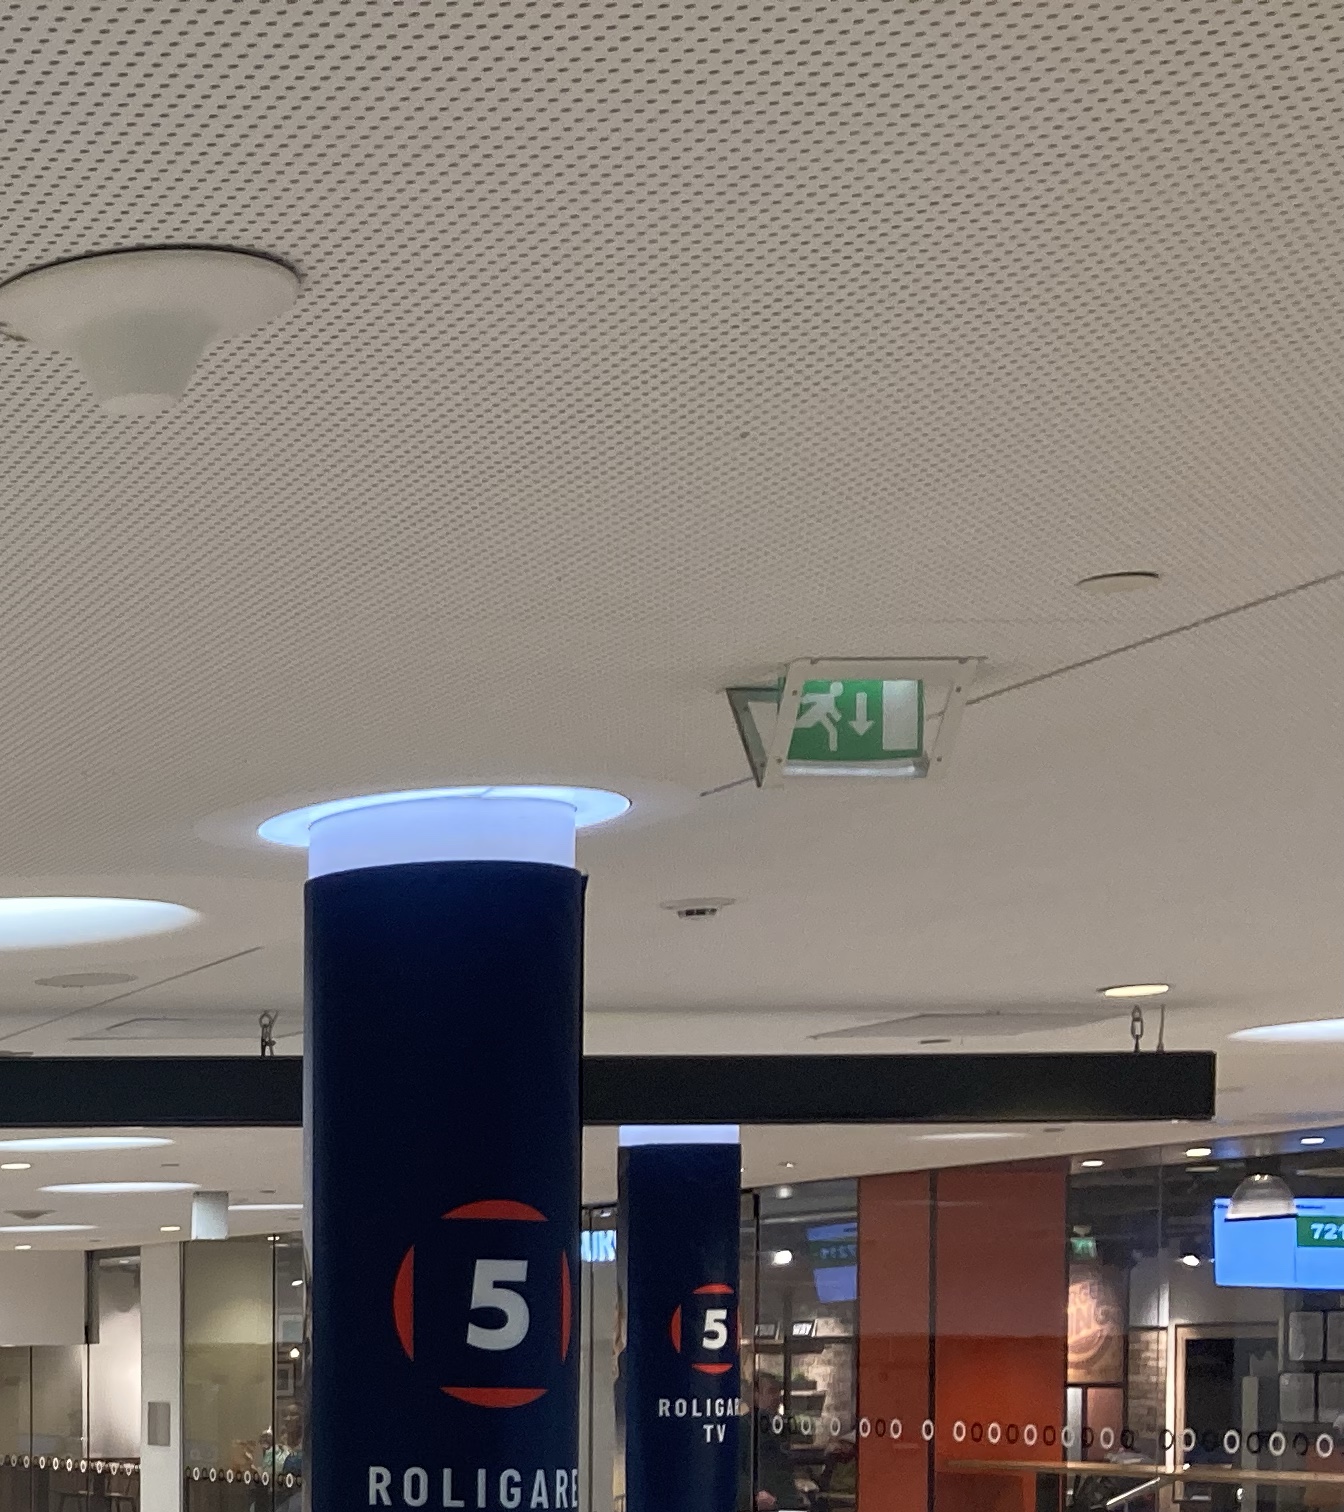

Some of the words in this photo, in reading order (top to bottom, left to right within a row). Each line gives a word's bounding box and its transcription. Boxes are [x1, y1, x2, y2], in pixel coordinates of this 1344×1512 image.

[466, 1258, 530, 1351] 5
[701, 1308, 729, 1350] 5
[703, 1423, 727, 1444] TV
